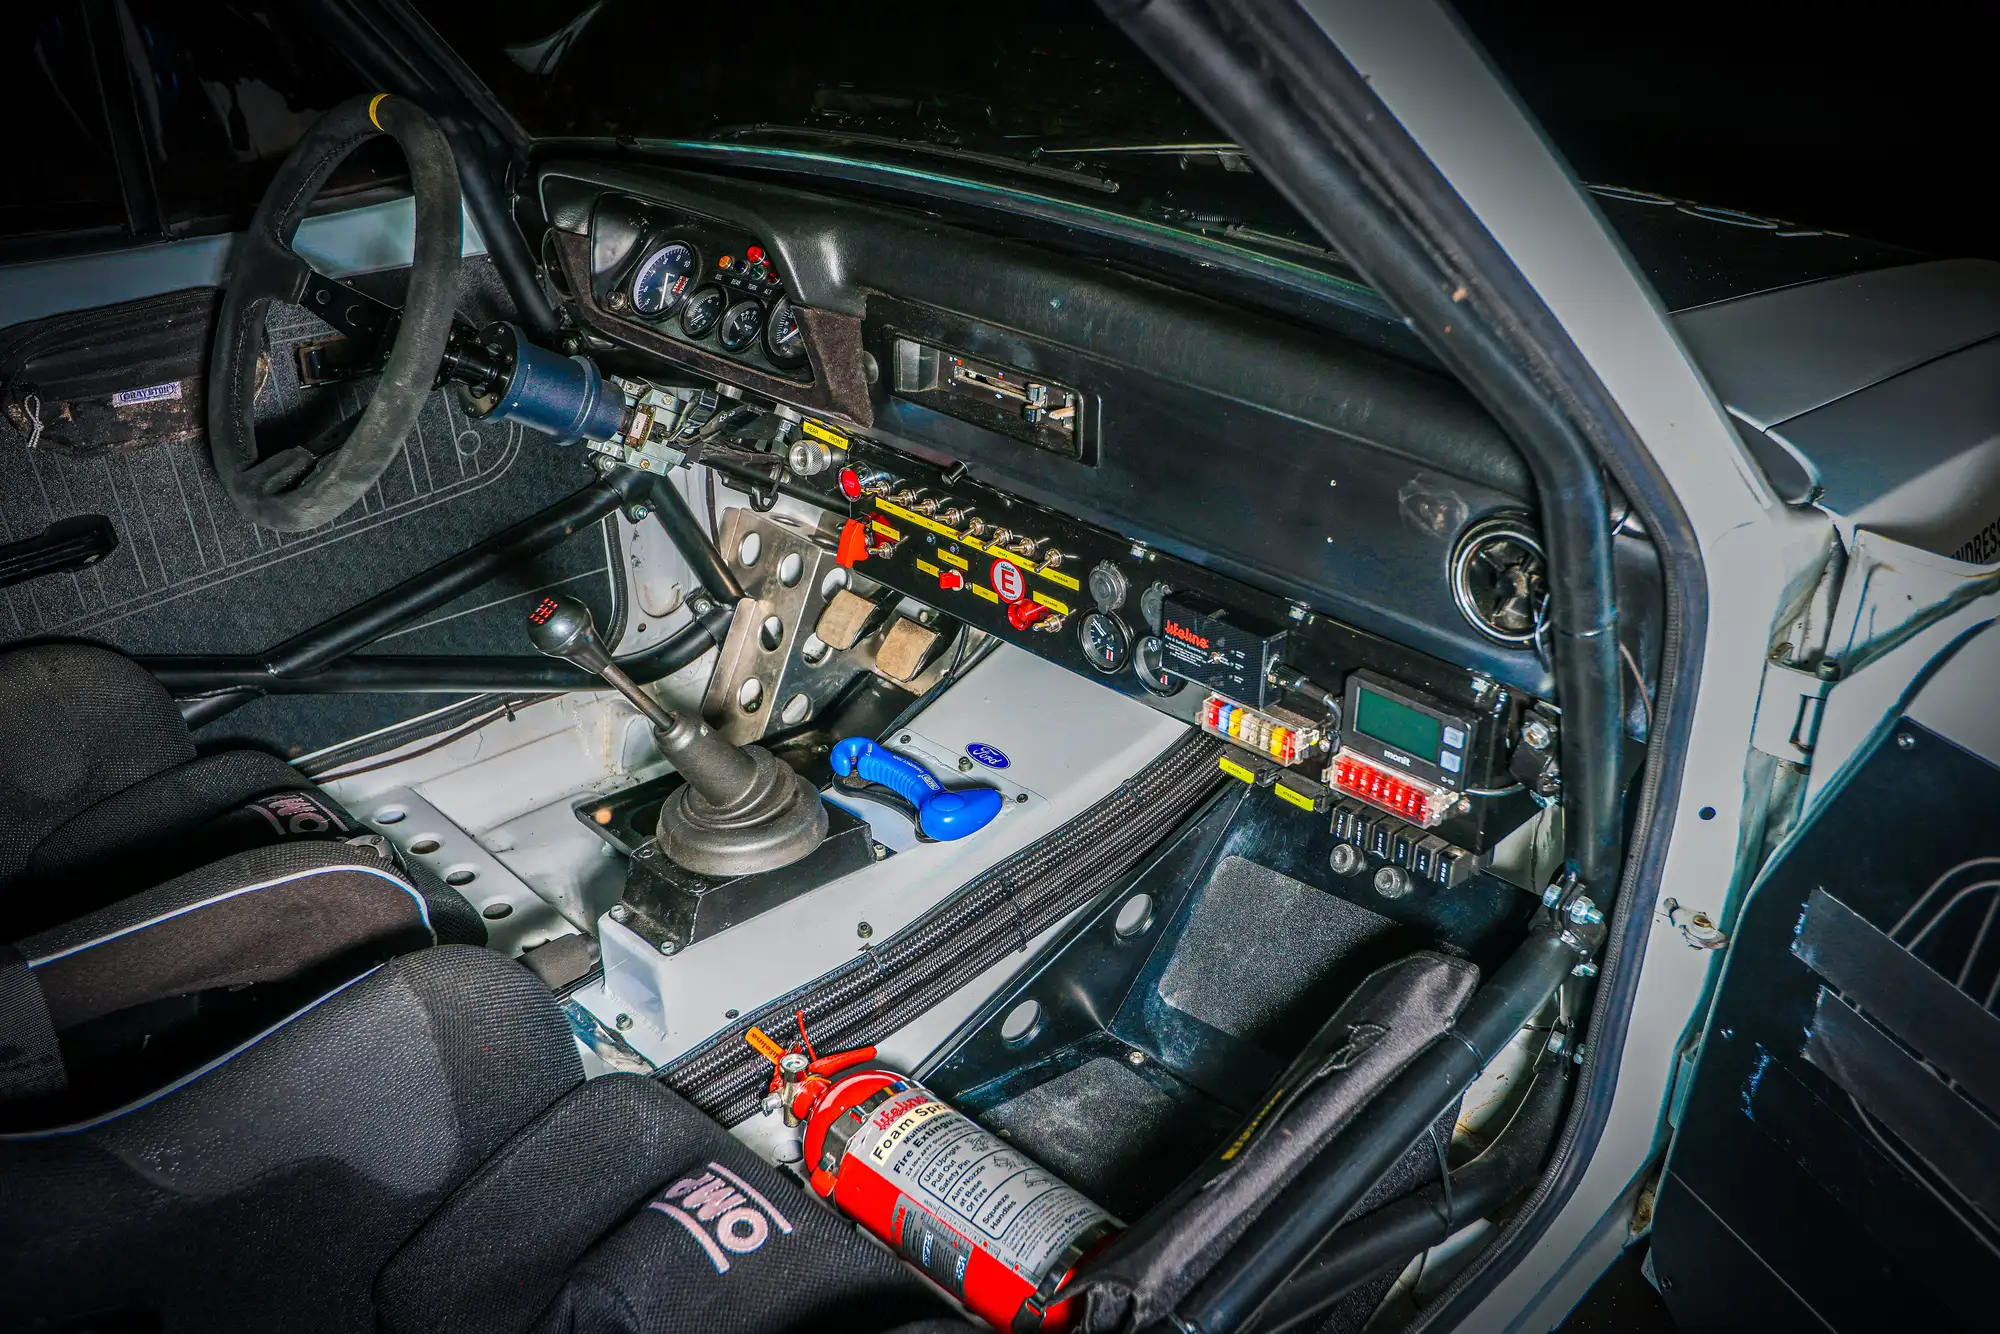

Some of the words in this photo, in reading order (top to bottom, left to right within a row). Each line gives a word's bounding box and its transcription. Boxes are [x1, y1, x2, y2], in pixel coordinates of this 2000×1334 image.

[806, 425, 819, 435] REAR
[828, 435, 844, 445] FRONT
[1001, 569, 1015, 595] E
[972, 746, 1003, 765] Ford
[1383, 750, 1410, 767] monit
[872, 1117, 915, 1160] Foam
[893, 1149, 914, 1174] Fire
[923, 1166, 938, 1182] Use
[935, 1144, 961, 1167] Upright
[931, 1171, 944, 1188] Pull
[943, 1159, 957, 1173] Out
[938, 1169, 960, 1193] Safety
[959, 1159, 971, 1170] Pin
[951, 1186, 964, 1202] Aim
[962, 1164, 986, 1187] Nozzle
[964, 1180, 982, 1197] Base
[966, 1201, 975, 1213] Of
[973, 1187, 988, 1203] Fire
[982, 1193, 1010, 1224] Squeeze
[990, 1200, 1017, 1230] Handles
